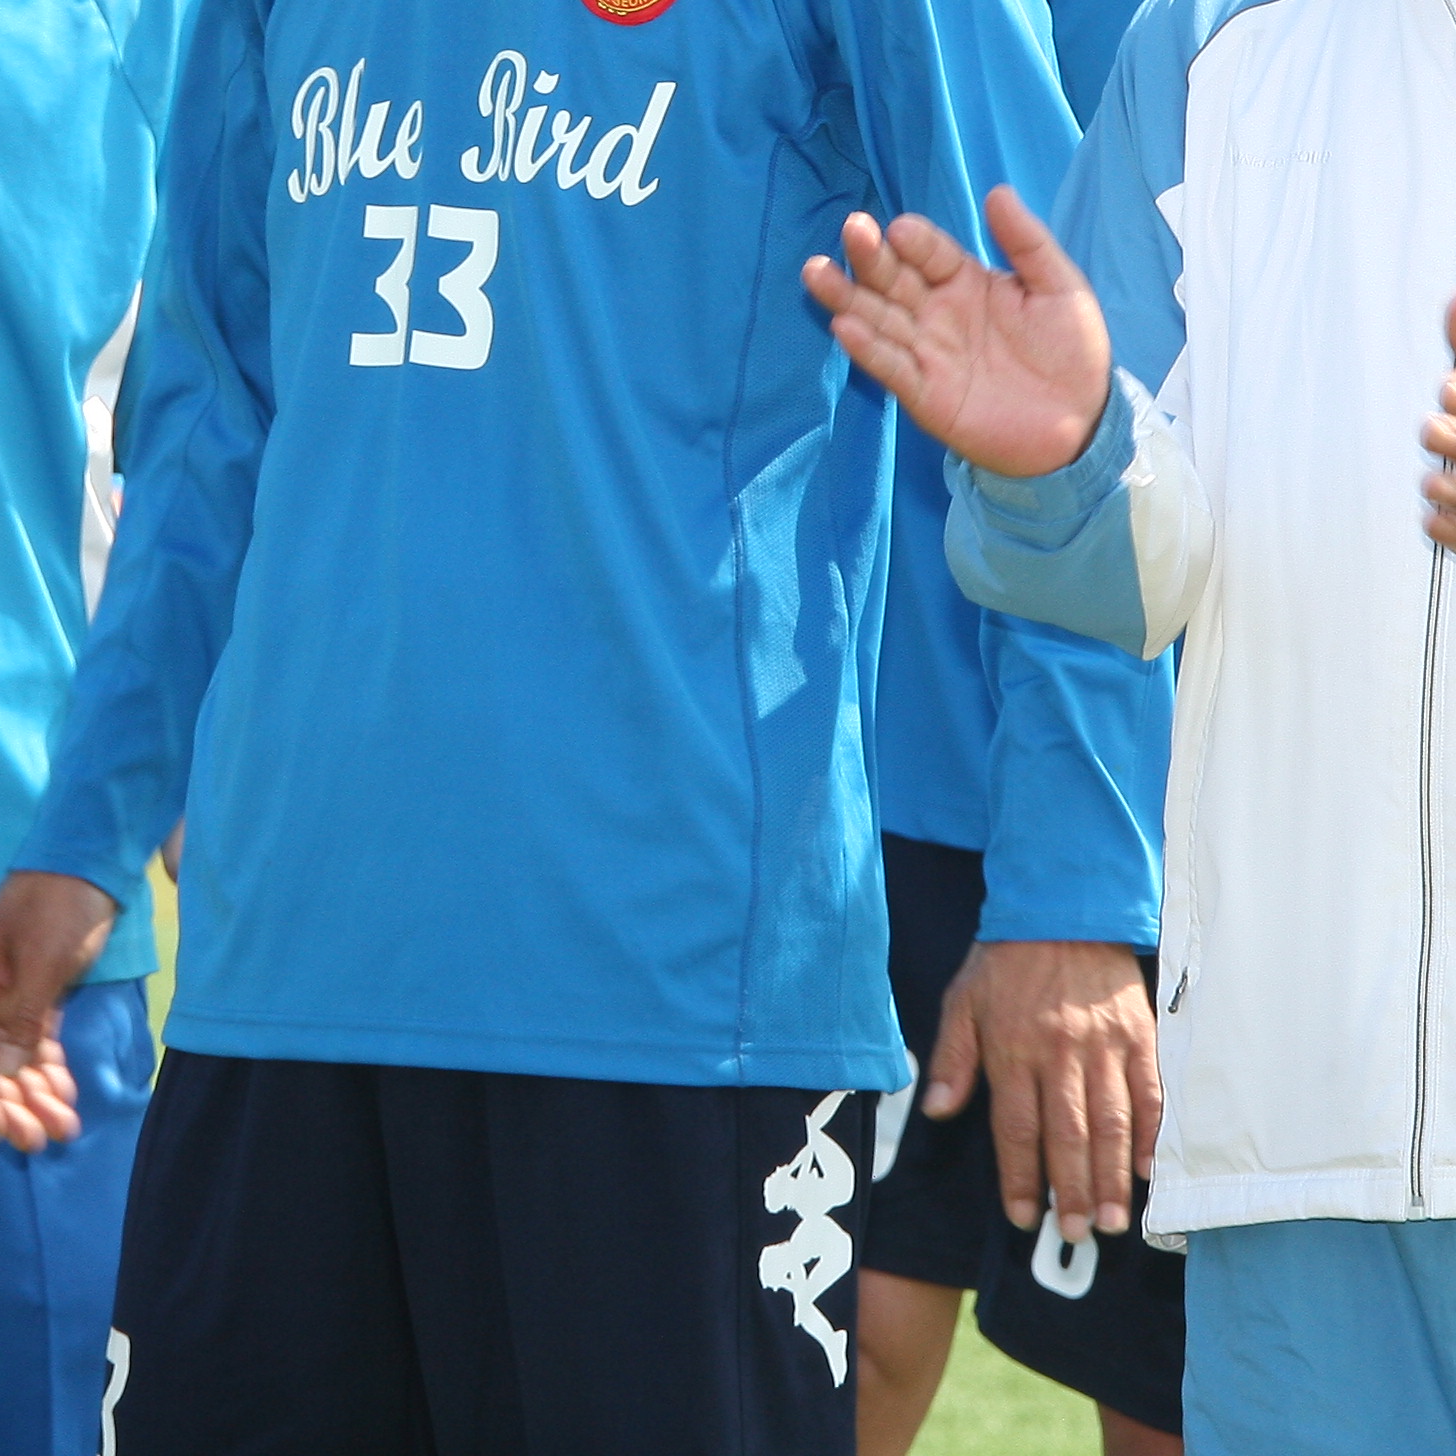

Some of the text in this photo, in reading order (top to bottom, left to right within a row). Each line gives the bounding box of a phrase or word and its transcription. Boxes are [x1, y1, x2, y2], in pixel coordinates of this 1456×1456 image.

[287, 50, 677, 207] Blue Bird
[349, 204, 499, 370] 33
